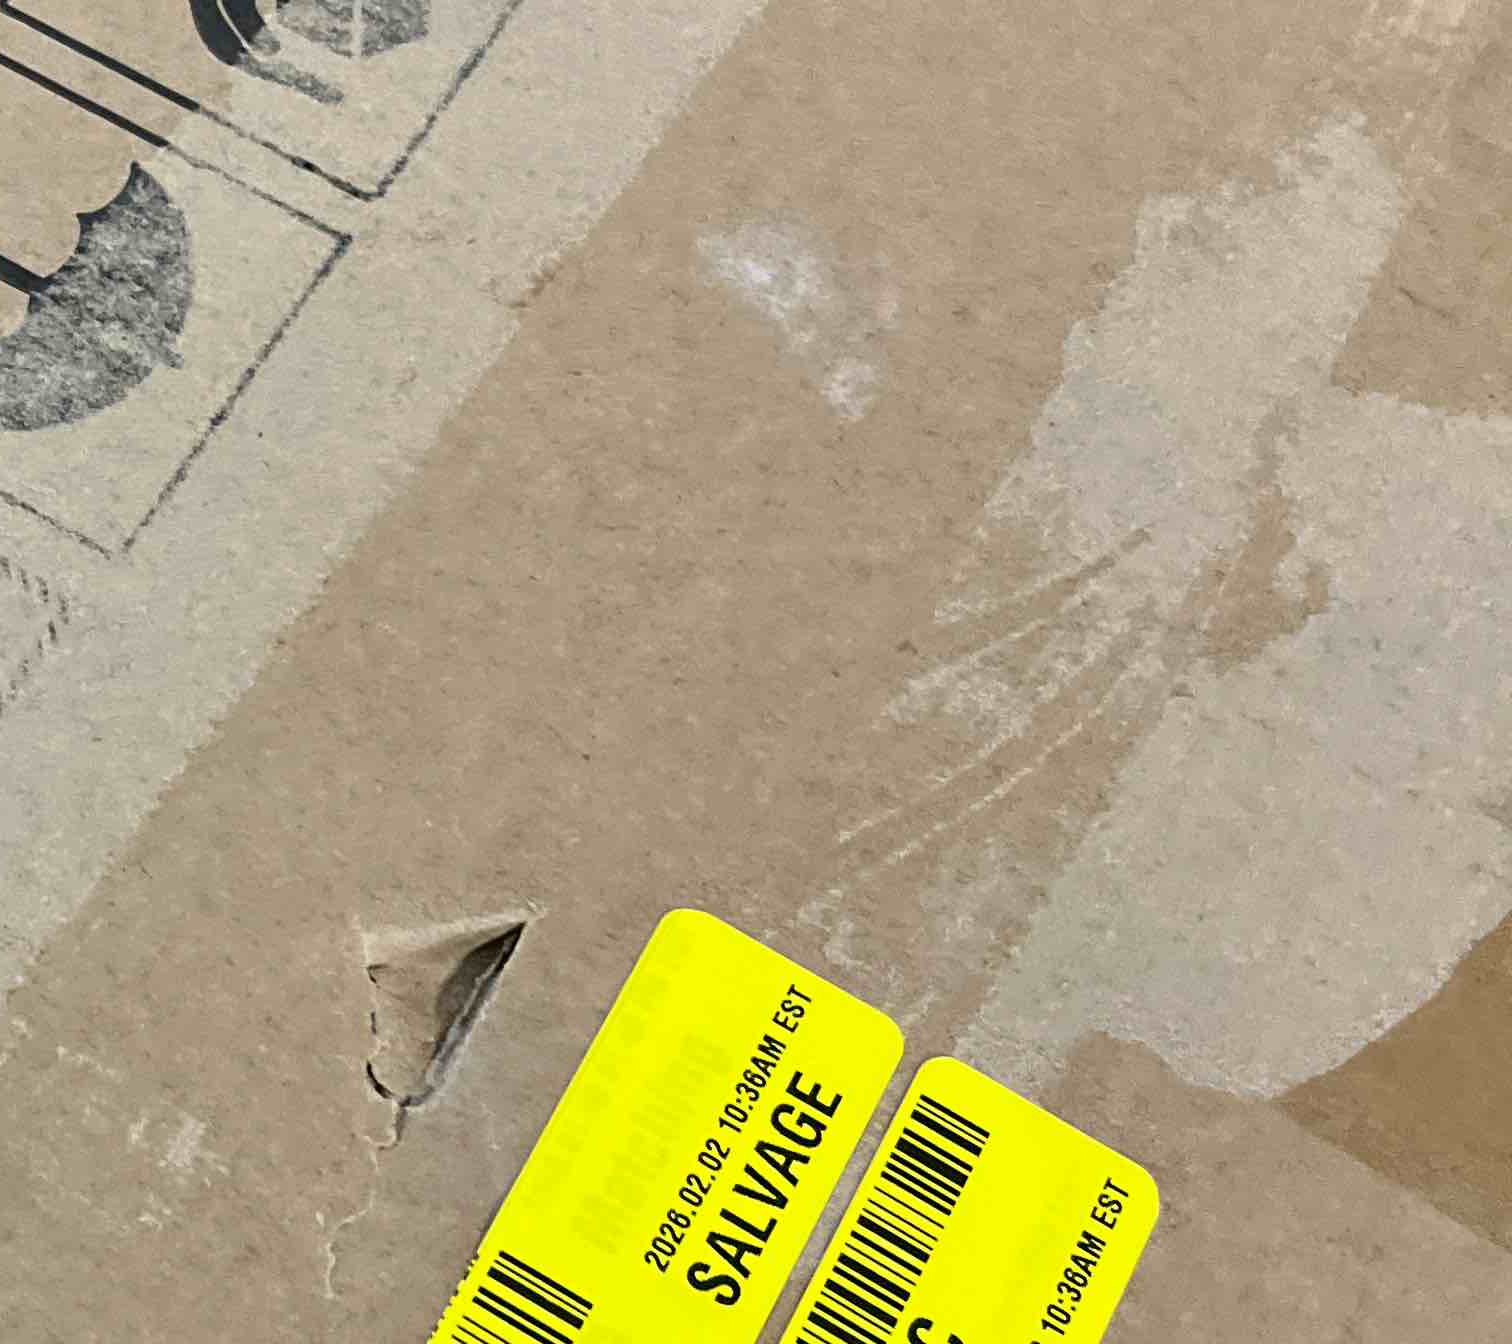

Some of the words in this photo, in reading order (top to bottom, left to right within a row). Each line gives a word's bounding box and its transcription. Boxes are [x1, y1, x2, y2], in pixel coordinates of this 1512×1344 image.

[645, 1139, 730, 1272] 2026.02.02
[719, 1035, 786, 1132] 10:36AM
[773, 984, 811, 1032] EST
[687, 1071, 842, 1305] SALVAGE
[1042, 1231, 1106, 1335] 10:36AM
[1091, 1178, 1128, 1229] EST
